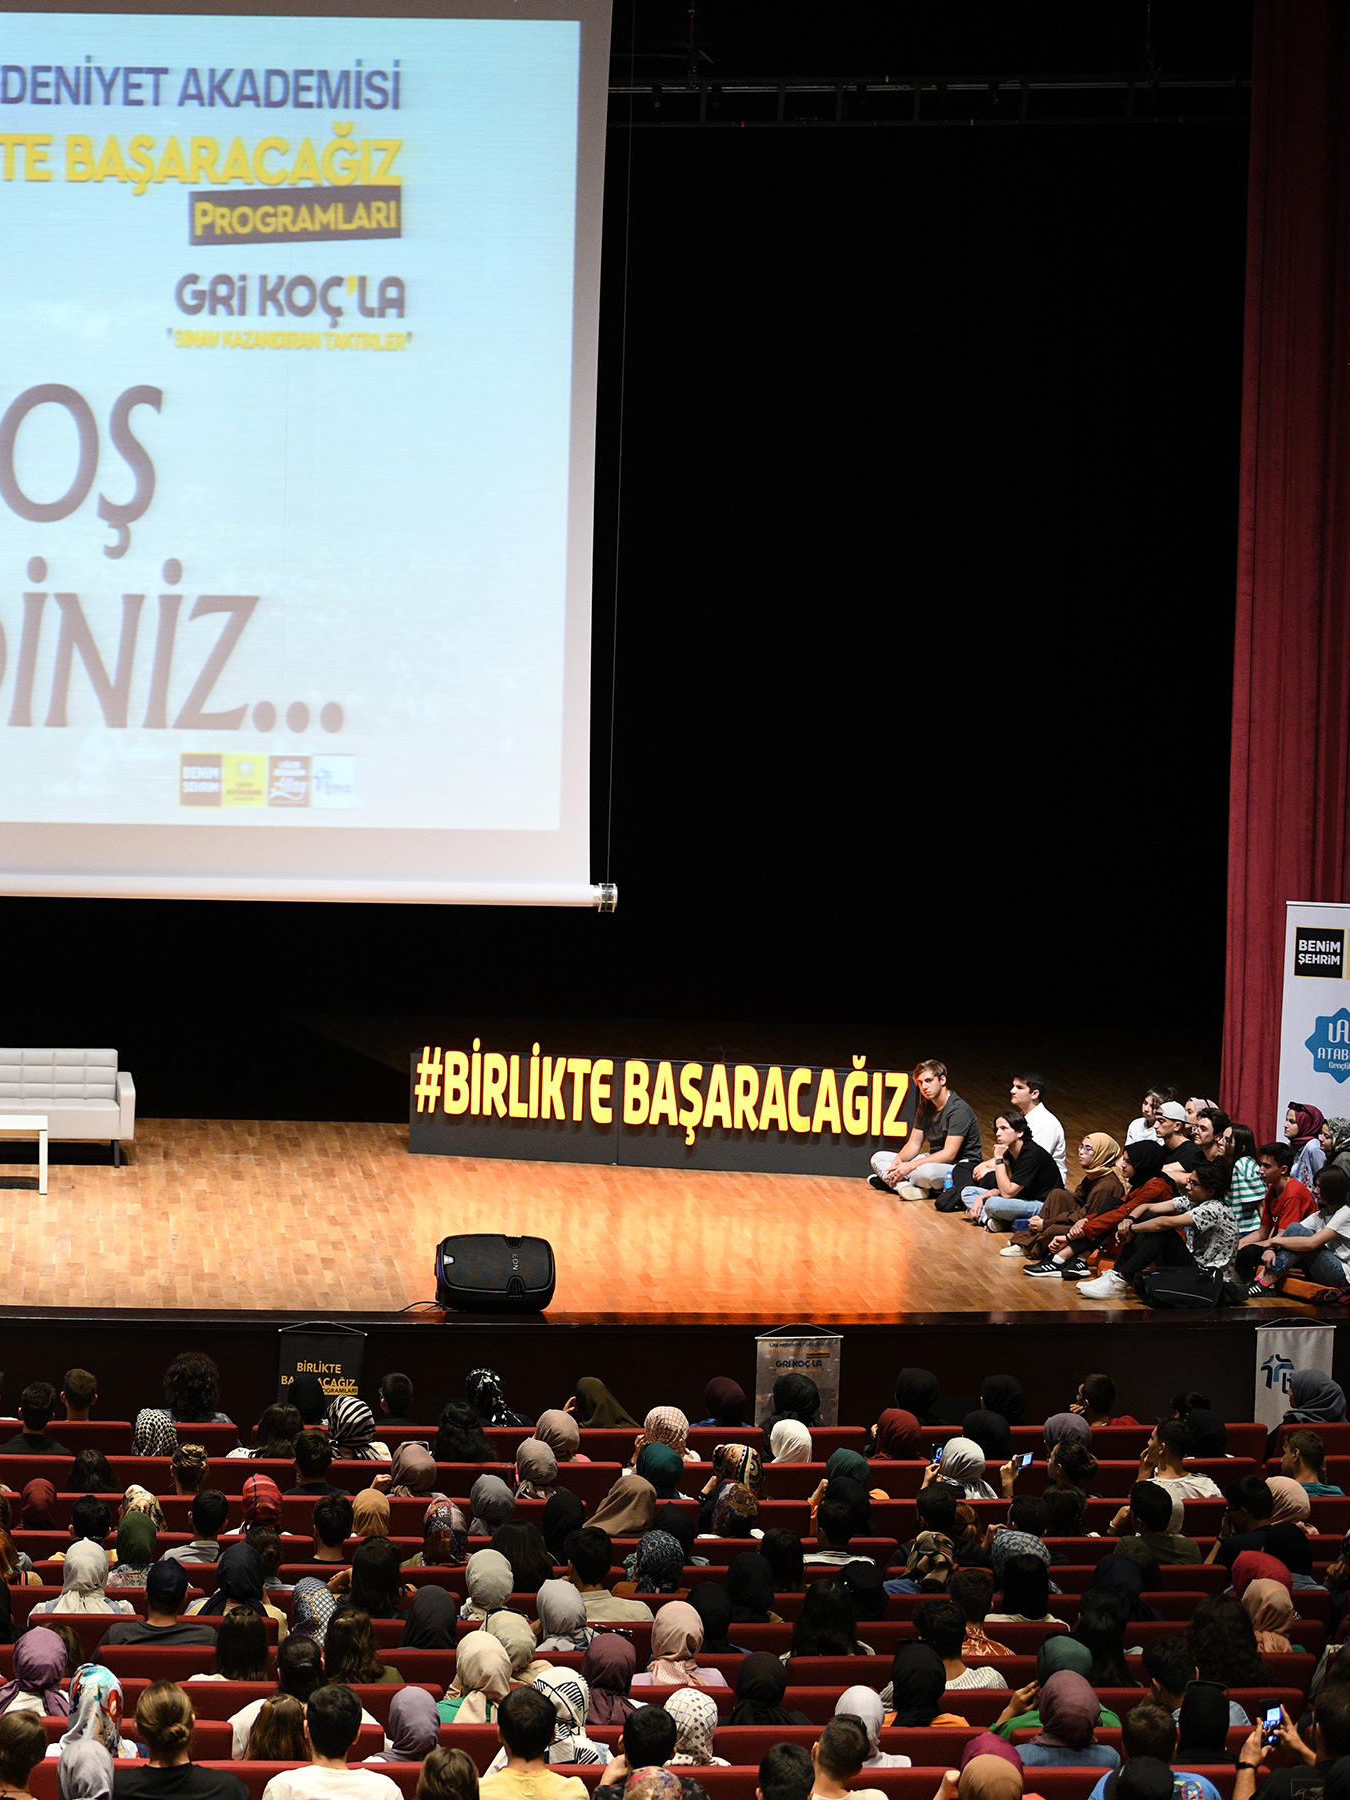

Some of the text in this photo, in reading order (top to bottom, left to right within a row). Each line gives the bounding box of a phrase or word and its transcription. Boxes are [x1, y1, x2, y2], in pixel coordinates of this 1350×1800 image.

[177, 58, 401, 110] AKADEMİSİ
[65, 121, 404, 195] BAŞARACAĞIZ
[1317, 1047, 1350, 1060] ATAB
[414, 1037, 909, 1146] #BİRLİKTE BAŞARACAĞIZ
[296, 1360, 342, 1374] BİRLİKTE
